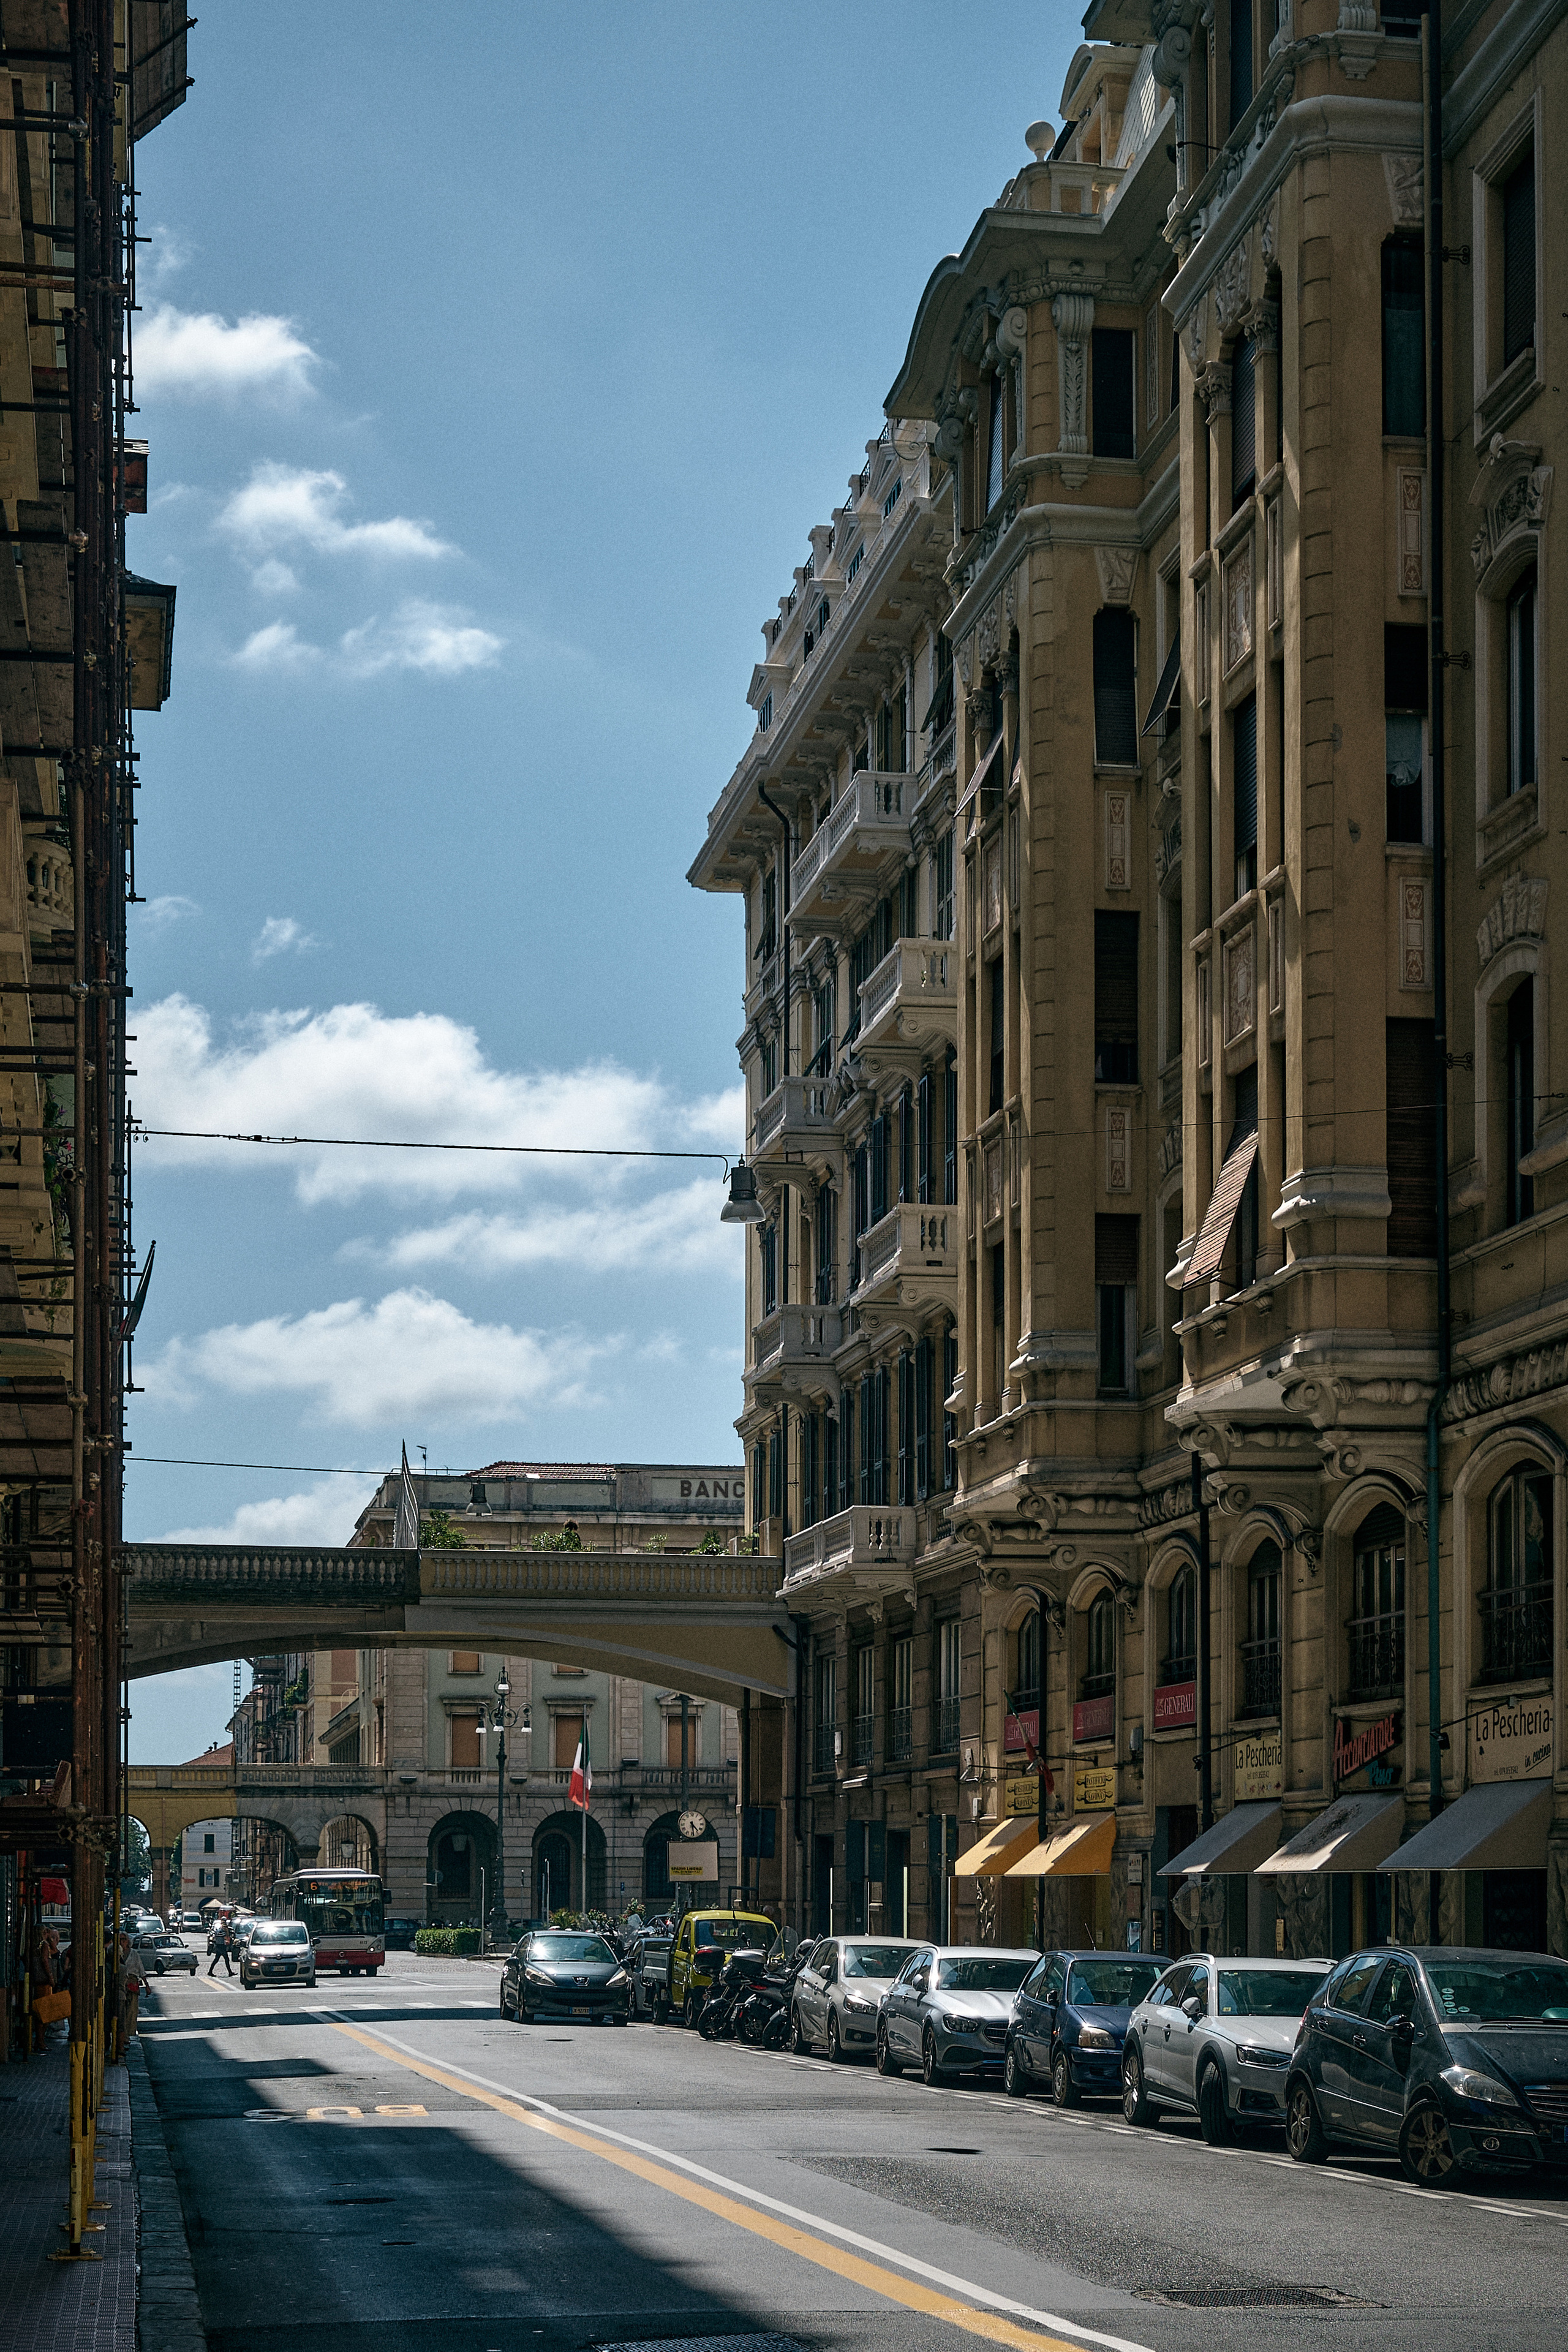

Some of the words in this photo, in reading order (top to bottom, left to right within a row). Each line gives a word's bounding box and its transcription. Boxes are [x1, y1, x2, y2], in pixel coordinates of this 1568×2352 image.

[1164, 1693, 1194, 1715] GENERALI
[1476, 1713, 1489, 1742] La
[1492, 1704, 1550, 1740] Pescheria
[1235, 1746, 1243, 1769] La
[1246, 1739, 1282, 1768] Pescheria
[310, 1882, 318, 1891] 6
